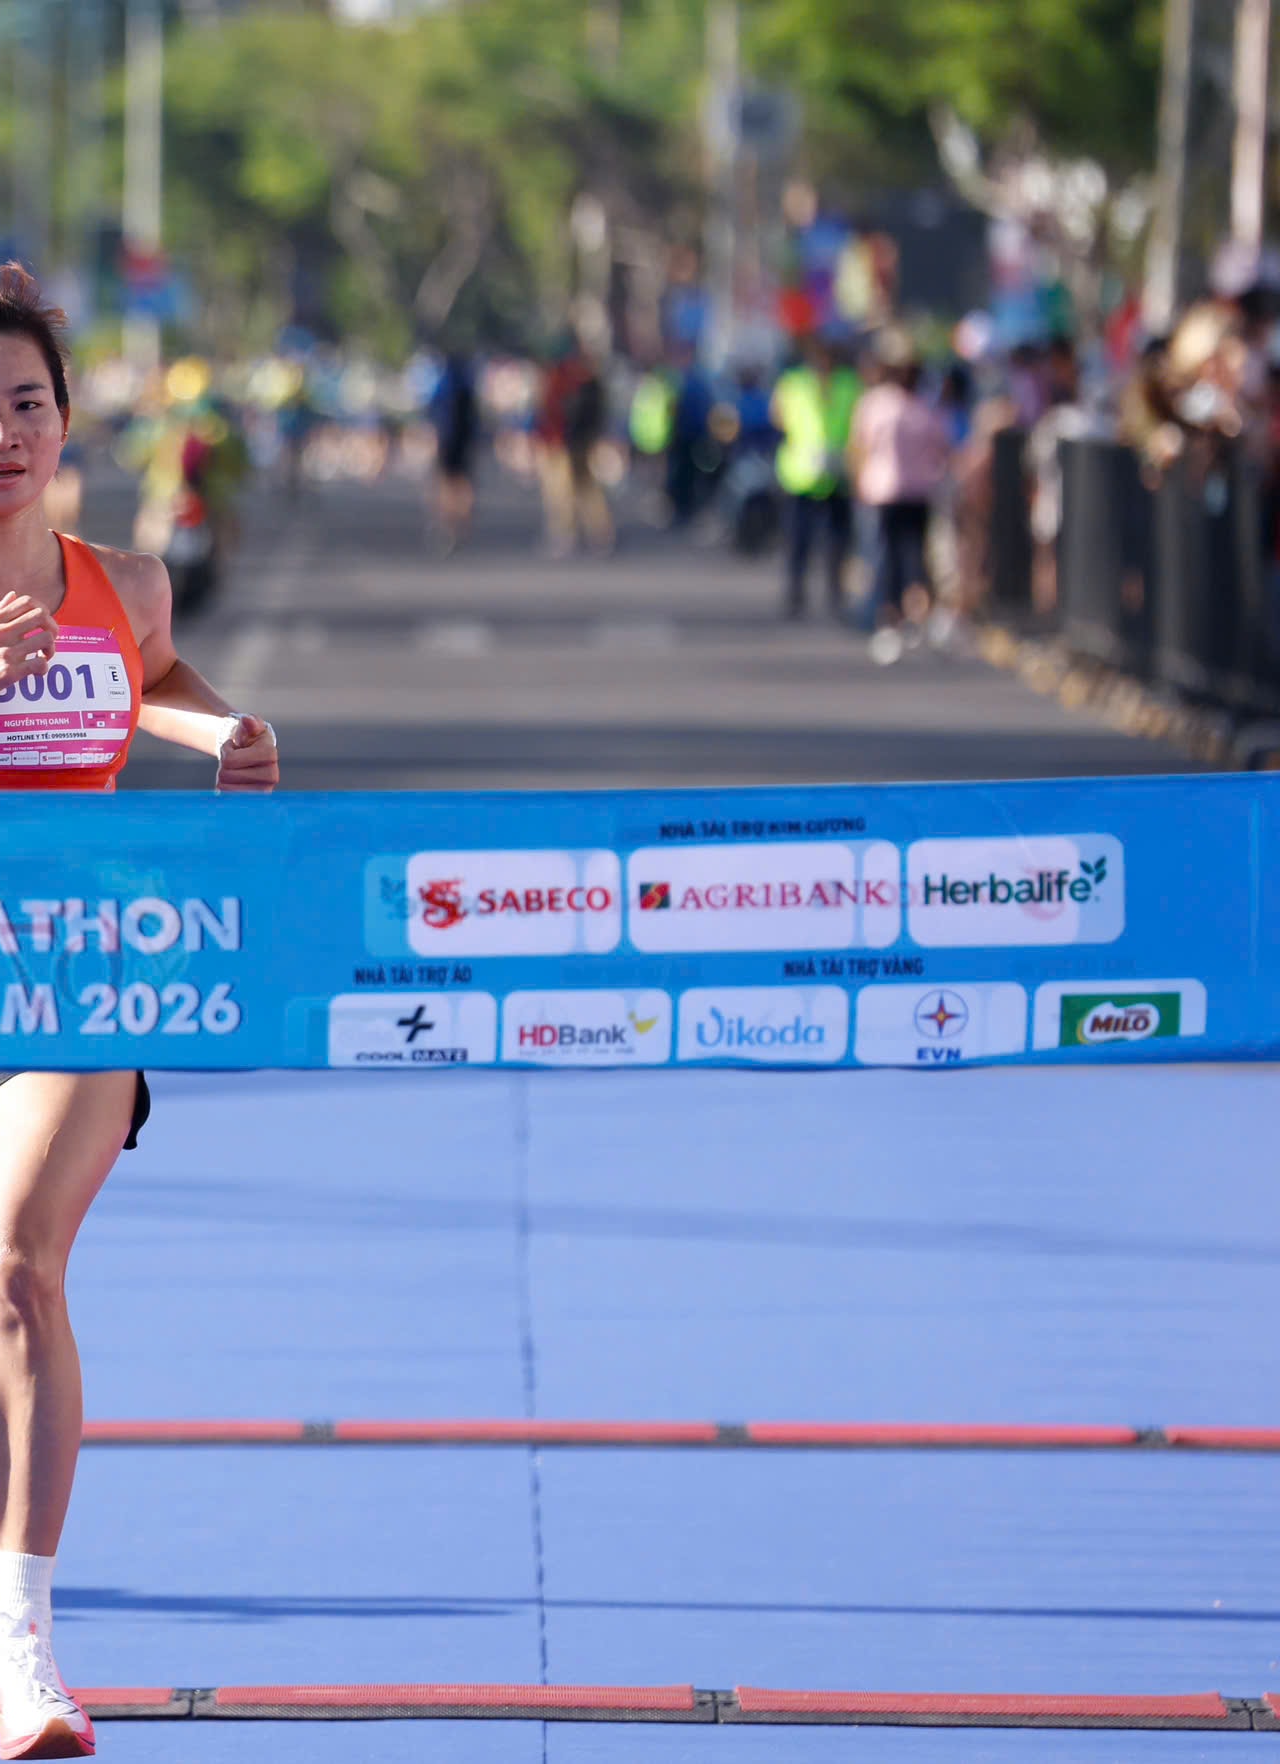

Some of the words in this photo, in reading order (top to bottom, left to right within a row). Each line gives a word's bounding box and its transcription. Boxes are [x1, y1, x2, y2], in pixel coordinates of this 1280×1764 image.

[111, 671, 119, 682] E
[4, 717, 34, 728] NGUYỄN
[48, 718, 70, 726] OANH
[7, 734, 35, 742] HOTLINE
[660, 819, 695, 839] NHÀ
[701, 818, 726, 837] TÀI
[732, 819, 764, 838] TRỢ
[769, 820, 801, 836] KIM
[679, 879, 887, 911] AGRIBANK
[923, 869, 1093, 906] Herbalife
[477, 886, 613, 914] SABECO
[354, 964, 386, 984] NHÀ
[390, 964, 414, 984] TÀI
[418, 965, 449, 987] TRỢ
[453, 962, 473, 983] ÁO
[784, 955, 817, 976] NHÀ
[822, 955, 844, 976] TÀI
[848, 957, 879, 979] TRỢ
[881, 953, 925, 976] VÀNG
[79, 982, 242, 1036] 2026
[696, 1007, 825, 1049] Vikoda
[1090, 1013, 1151, 1033] MILO
[519, 1024, 627, 1047] HDBank
[916, 1047, 962, 1062] EVN
